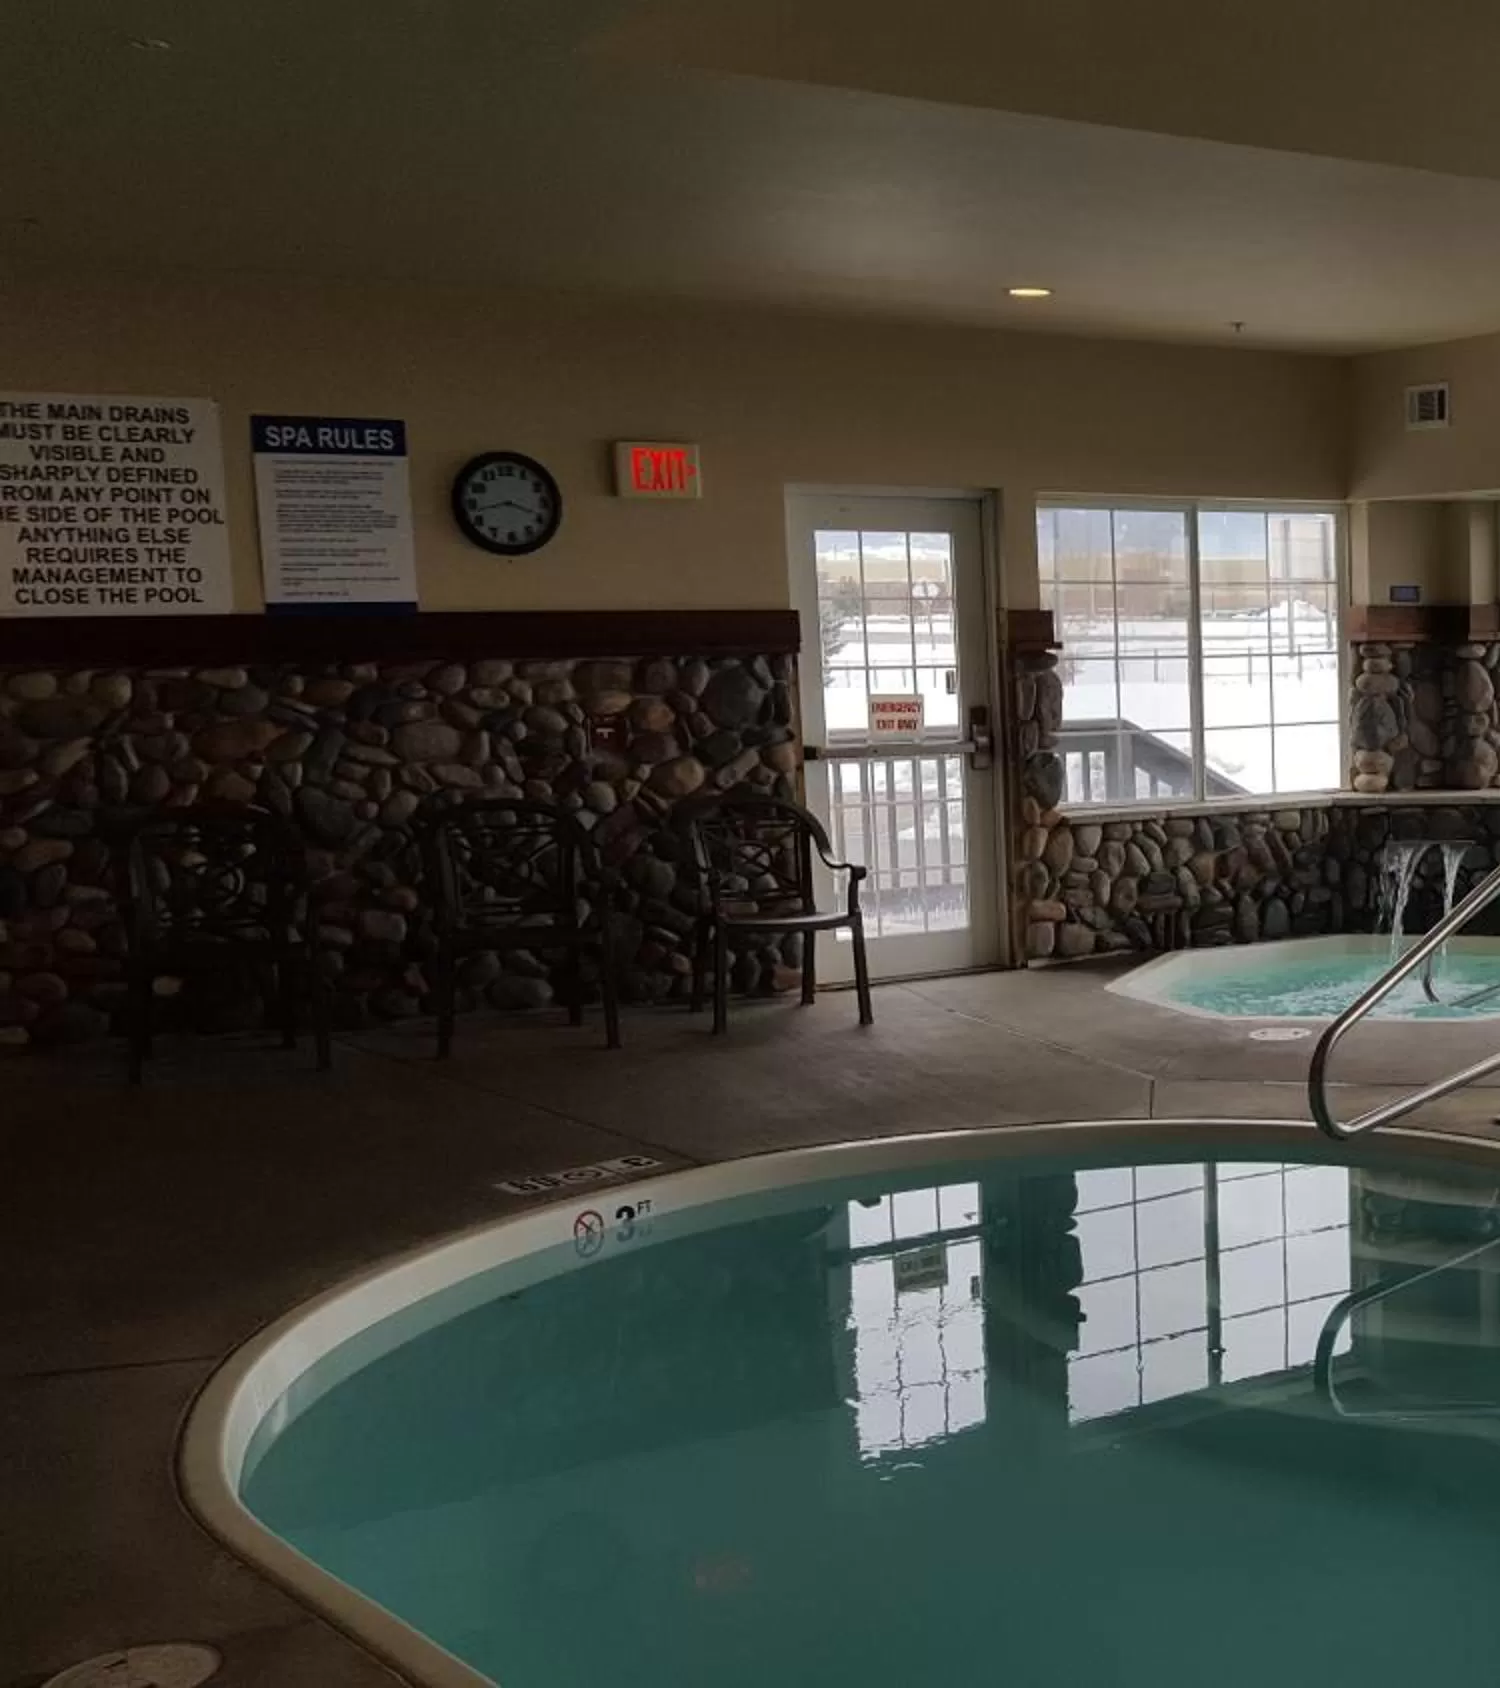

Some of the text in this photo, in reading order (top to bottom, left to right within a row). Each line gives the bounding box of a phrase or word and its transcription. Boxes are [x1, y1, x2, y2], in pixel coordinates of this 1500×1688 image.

[0, 403, 190, 424] THE MAIN DRAINS
[62, 426, 92, 441] BE
[98, 426, 195, 444] CLEARLY
[265, 425, 395, 449] SPA RULES
[29, 445, 165, 463] VISIBLE AND
[0, 465, 198, 484] SHARPLY DEFINED
[631, 447, 686, 493] EXIT
[2, 486, 210, 504] ROM ANY POINT ON
[27, 506, 77, 522] SIDE
[84, 507, 113, 523] OF
[120, 507, 161, 523] THE
[167, 508, 225, 524] POOL
[18, 527, 192, 543] ANYTHING ELSE
[27, 548, 186, 563] REQUIRES THE
[12, 568, 203, 584] MANAGEMENT TO
[15, 588, 204, 605] CLOSE THE POOL
